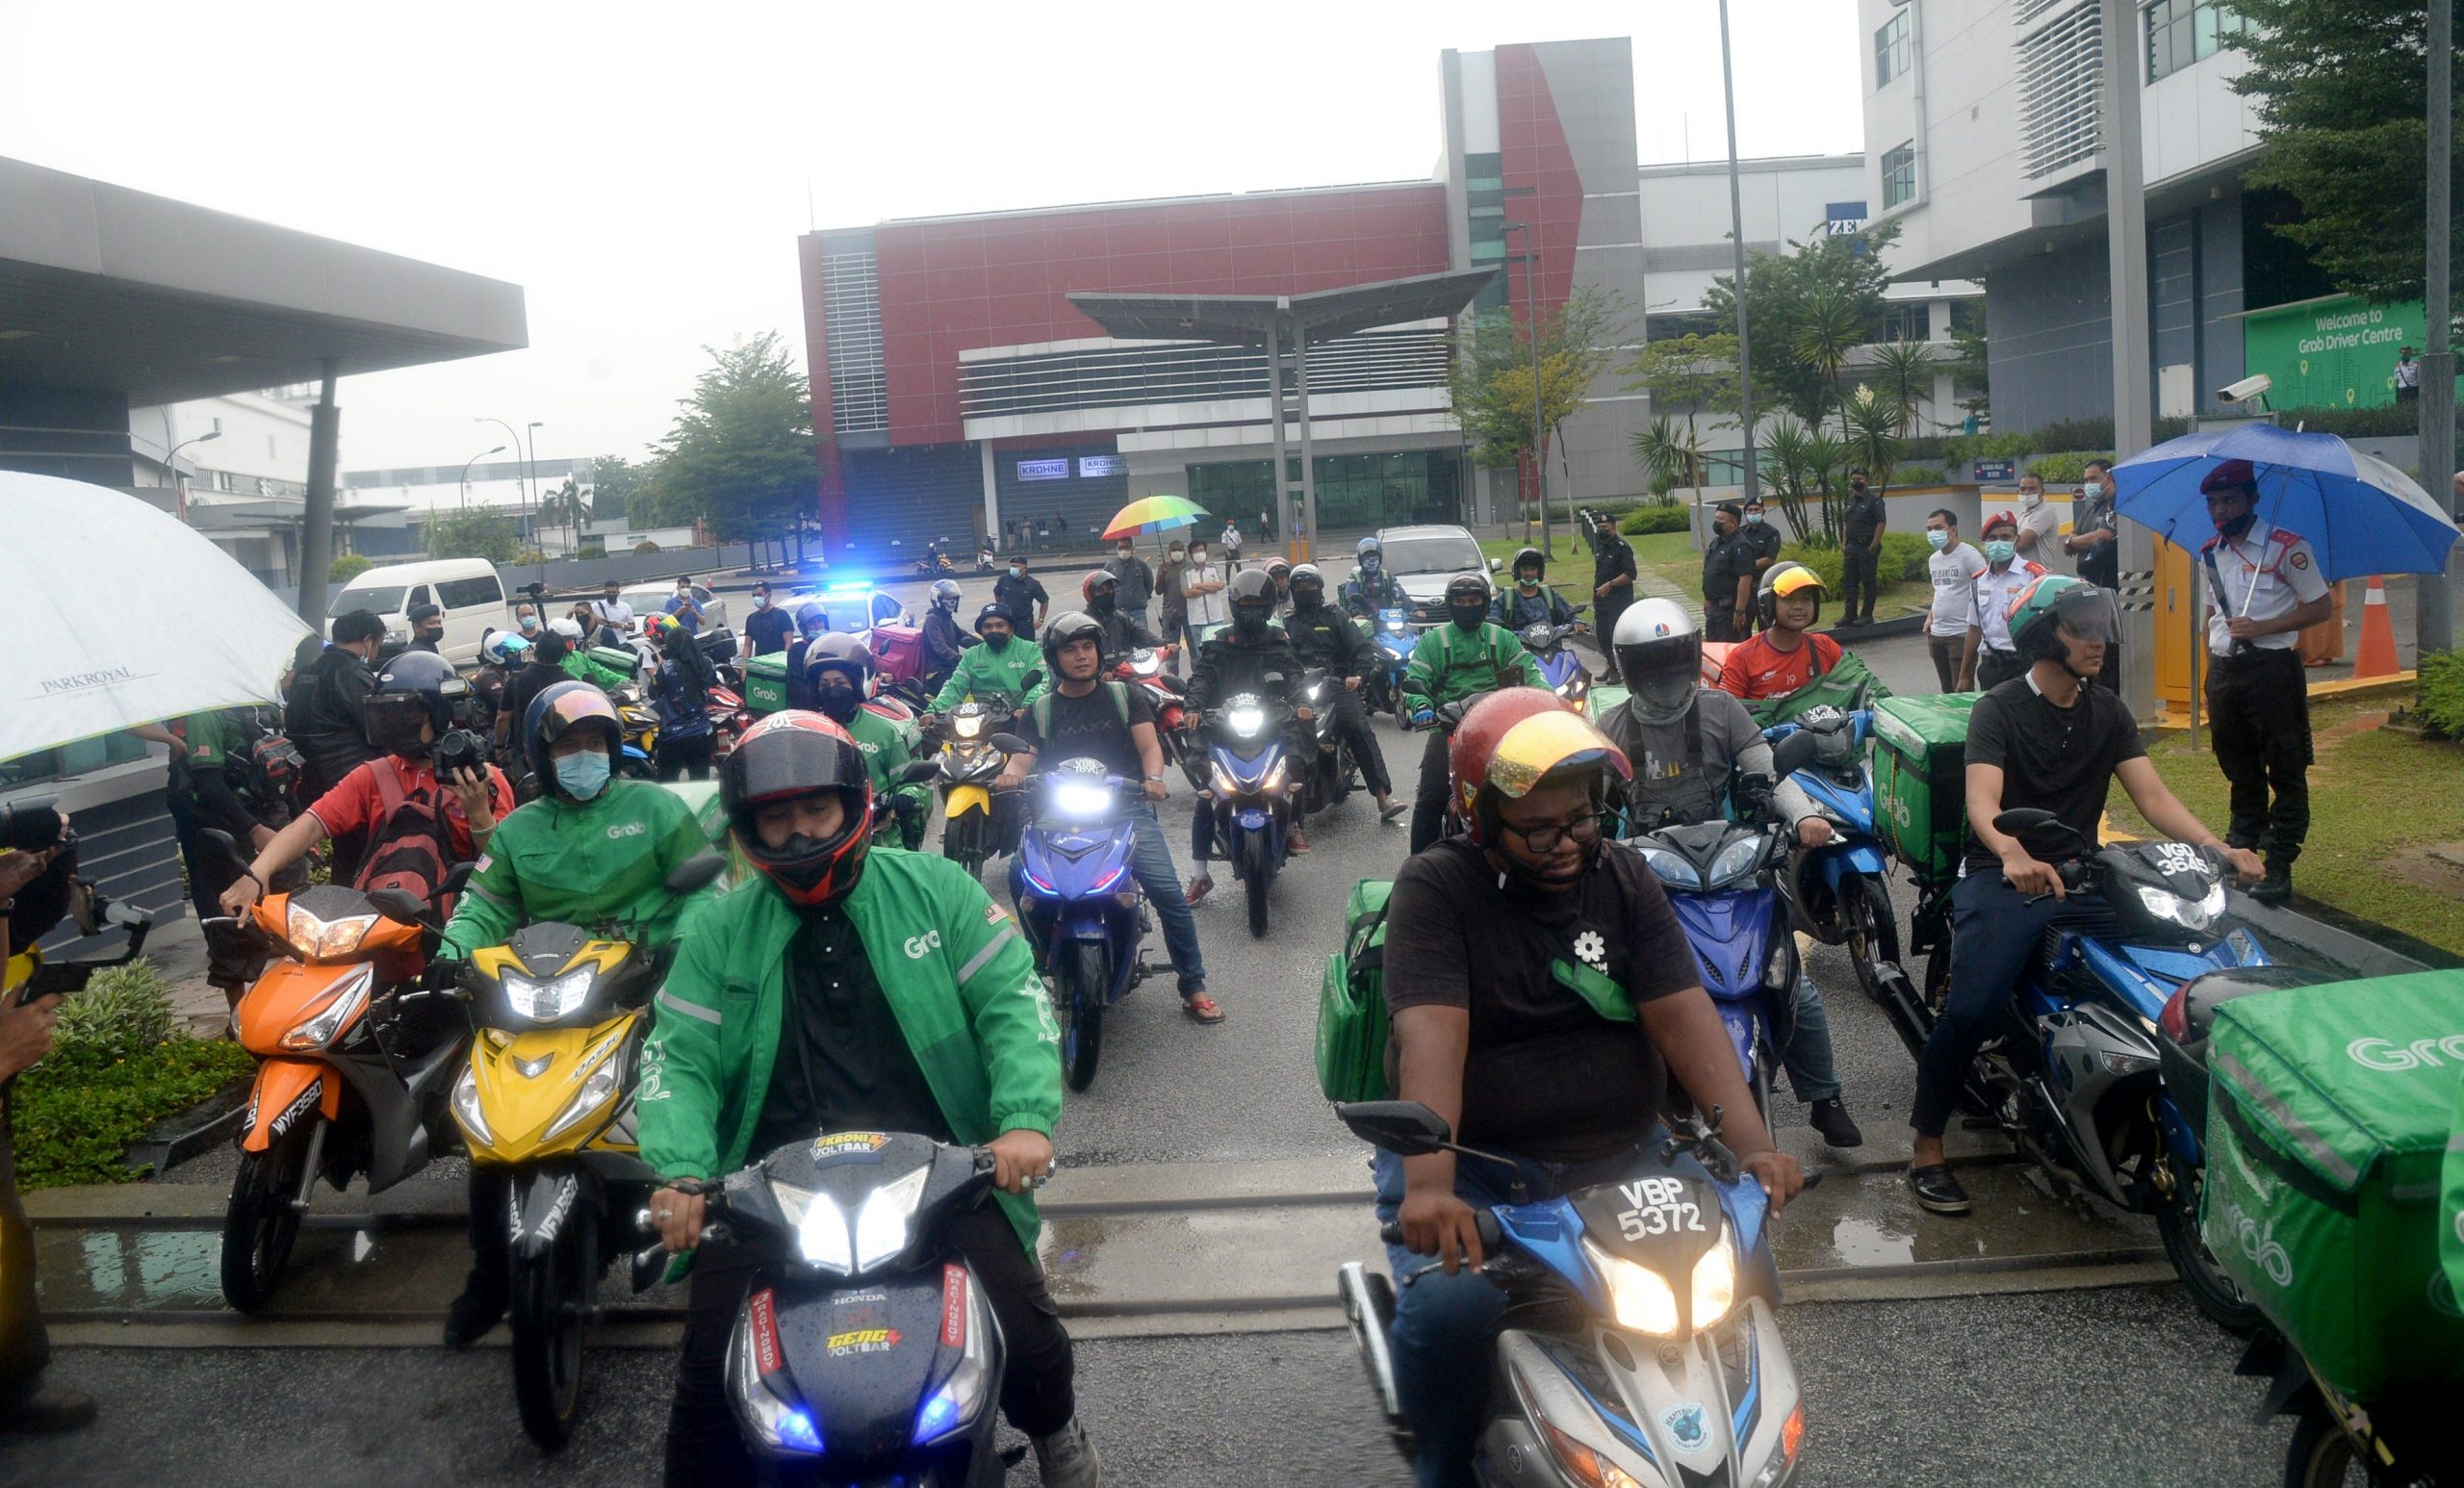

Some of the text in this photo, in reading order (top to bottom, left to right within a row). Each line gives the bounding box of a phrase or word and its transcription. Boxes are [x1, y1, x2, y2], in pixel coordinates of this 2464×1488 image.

[2316, 309, 2383, 331] Welcome to
[2298, 327, 2403, 353] Grab Driver Centre
[1021, 464, 1065, 475] KROHNE
[1087, 459, 1125, 468] KROHNE
[40, 666, 135, 693] PARKROYAL
[753, 687, 778, 702] Grab
[607, 821, 646, 839] Grab
[2156, 842, 2195, 859] VGD
[2157, 856, 2210, 877] 3645
[270, 1079, 323, 1137] WYF3580
[813, 1142, 871, 1158] VOLTBAR
[1619, 1177, 1684, 1210] VBP
[1617, 1202, 1707, 1243] 5372
[2221, 1186, 2294, 1287] rab
[834, 1294, 887, 1305] HONDA
[827, 1329, 888, 1349] GENG
[827, 1343, 890, 1358] VOLTBAR
